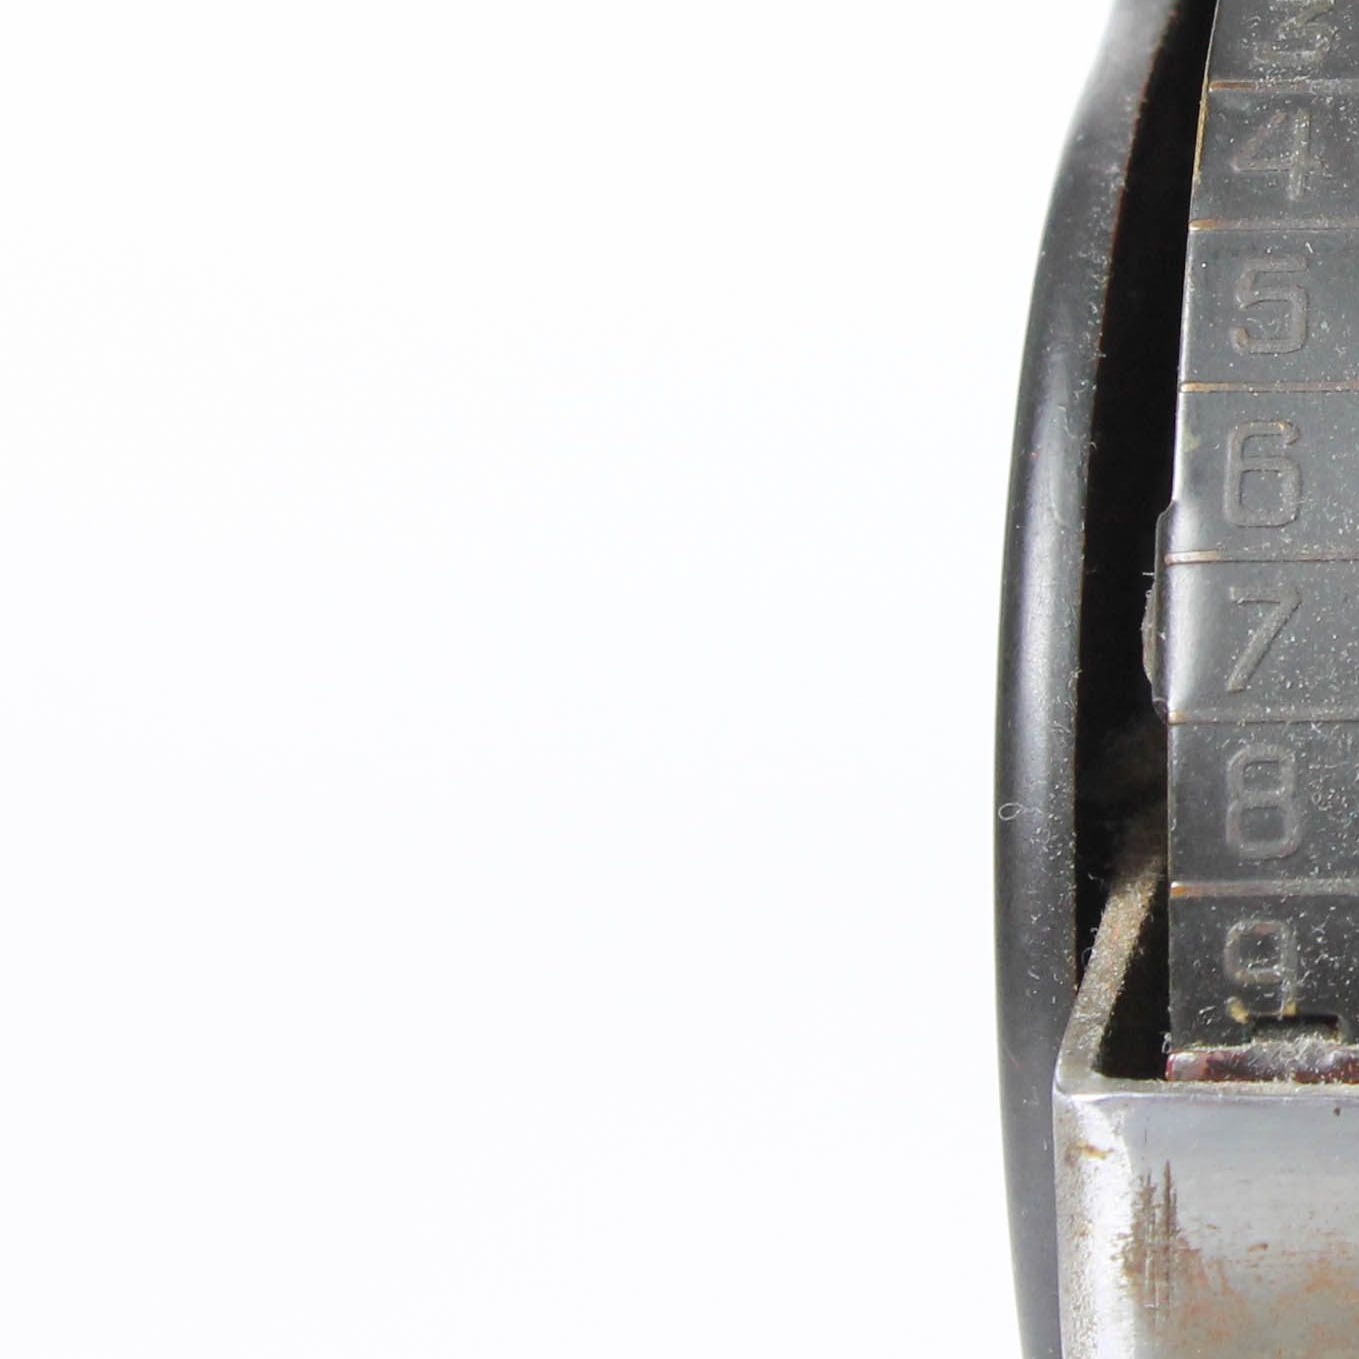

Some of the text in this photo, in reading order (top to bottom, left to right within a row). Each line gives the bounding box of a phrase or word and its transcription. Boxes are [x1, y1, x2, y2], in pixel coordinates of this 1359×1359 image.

[1230, 107, 1328, 202] 4
[1232, 256, 1310, 355] 5
[1223, 419, 1300, 528] 6
[1227, 586, 1301, 693] 7
[1224, 748, 1300, 861] 8
[1224, 920, 1300, 1025] 9
